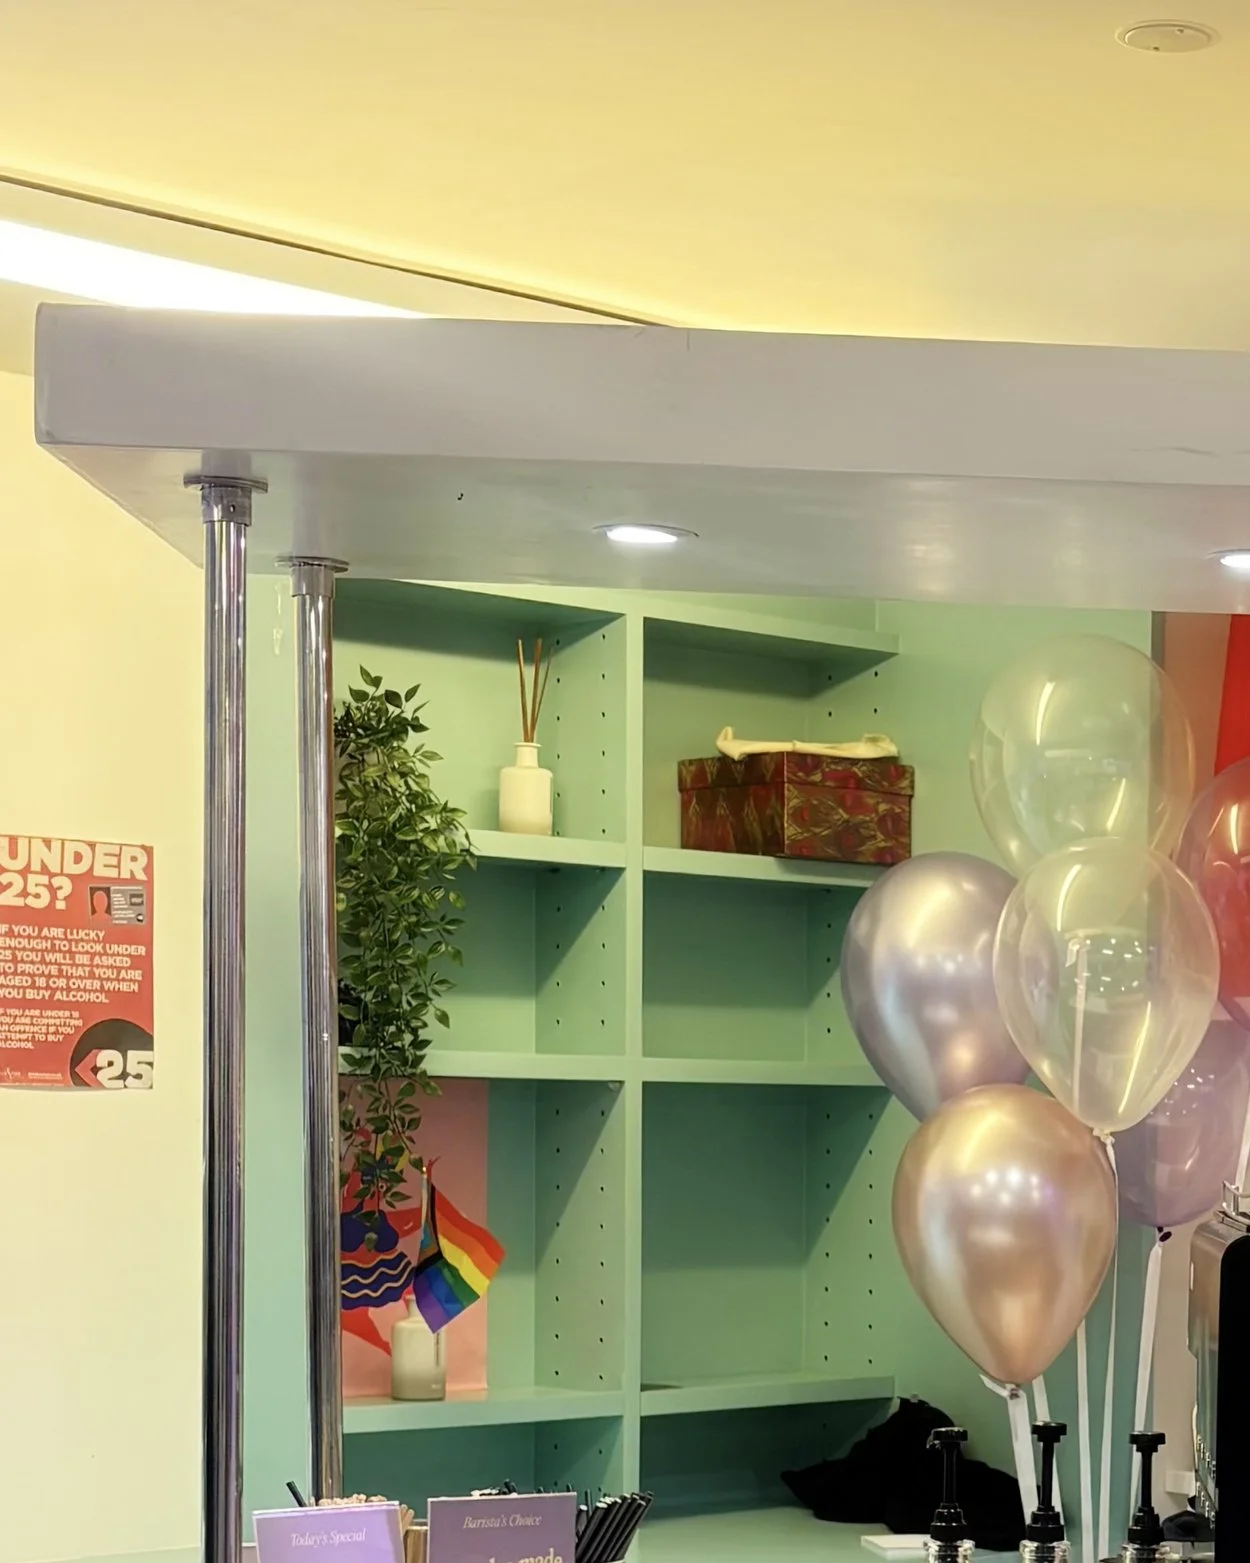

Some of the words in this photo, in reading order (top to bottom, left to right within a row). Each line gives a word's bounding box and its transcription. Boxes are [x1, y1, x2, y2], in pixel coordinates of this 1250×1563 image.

[0, 837, 148, 881] UNDER
[0, 872, 73, 909] 25?
[12, 924, 39, 936] YOU
[41, 927, 65, 938] ARE
[66, 928, 105, 940] LUCKY
[0, 937, 51, 950] ENOUGH
[54, 940, 69, 951] TO
[71, 942, 104, 954] LOOK
[106, 944, 146, 957] UNDER
[16, 950, 42, 961] YOU
[44, 951, 73, 964] WILL
[75, 953, 91, 965] BE
[93, 955, 131, 968] ASKED
[0, 962, 15, 973] TO
[17, 963, 59, 975] PROVE
[61, 965, 91, 977] THAT
[93, 967, 117, 979] YOU
[119, 969, 143, 981] ARE
[0, 975, 31, 986] AGED
[35, 976, 46, 986] 18
[49, 977, 66, 989] OR
[69, 978, 101, 990] OVER
[103, 980, 138, 993] WHEN
[25, 988, 51, 1001] BUY
[54, 990, 110, 1004] ALCOHOL
[0, 1015, 13, 1024] OU
[42, 1009, 71, 1018] UNDER
[463, 1515, 508, 1529] Barista's
[509, 1513, 542, 1527] Choice
[291, 1531, 328, 1548] Today's
[330, 1528, 366, 1547] Special
